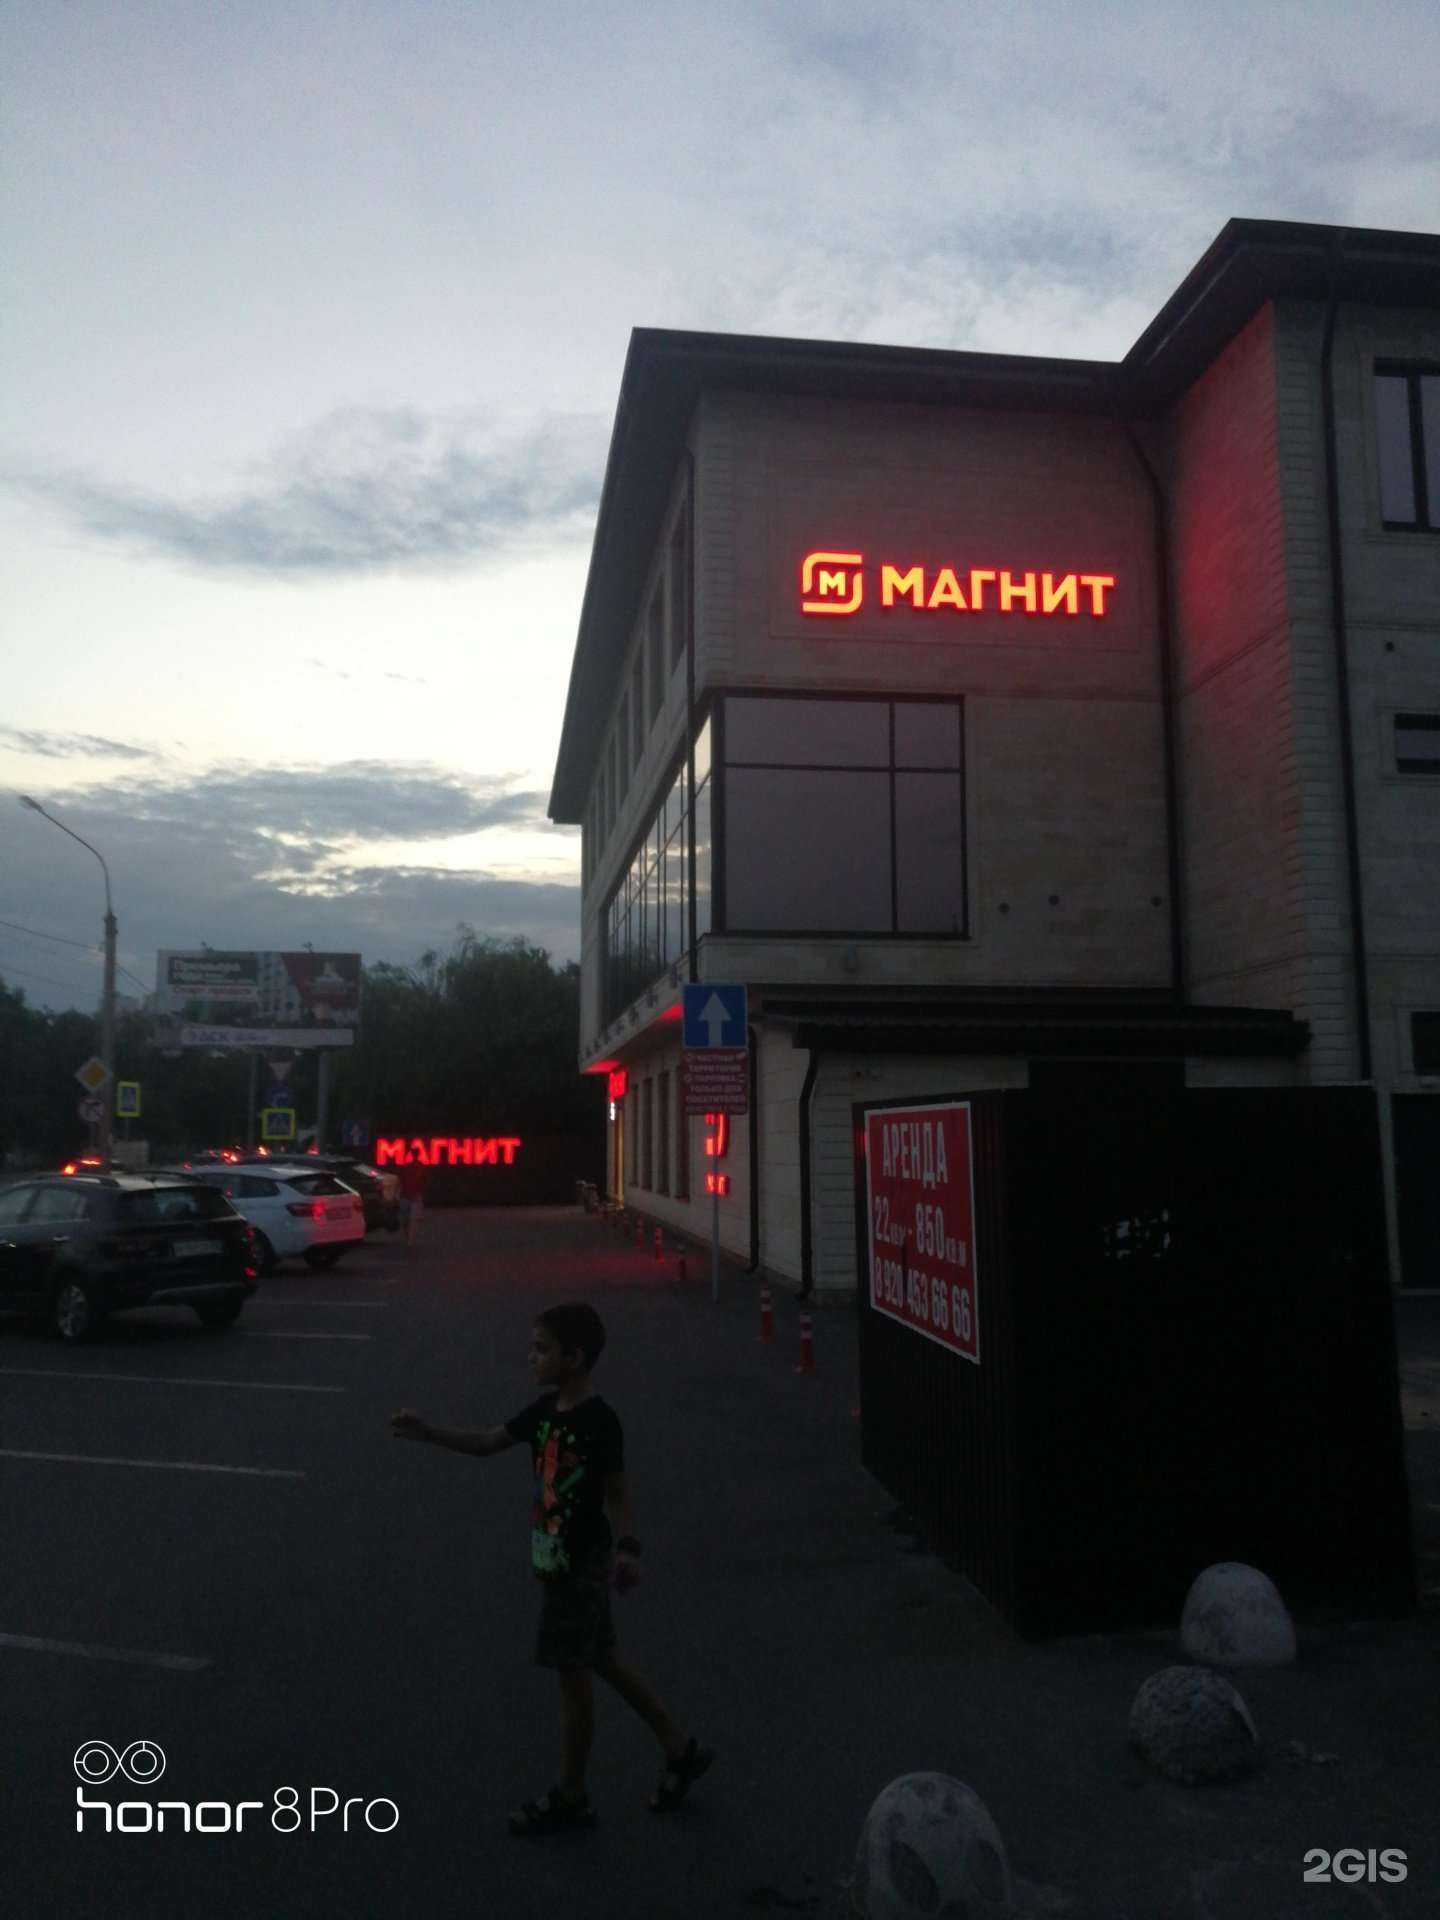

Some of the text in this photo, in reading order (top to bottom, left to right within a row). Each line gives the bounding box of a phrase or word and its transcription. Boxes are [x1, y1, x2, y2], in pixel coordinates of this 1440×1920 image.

[881, 564, 1115, 617] МАГНИТ
[376, 1137, 521, 1166] МАГНИТ
[882, 1121, 949, 1190] АРЕНДА
